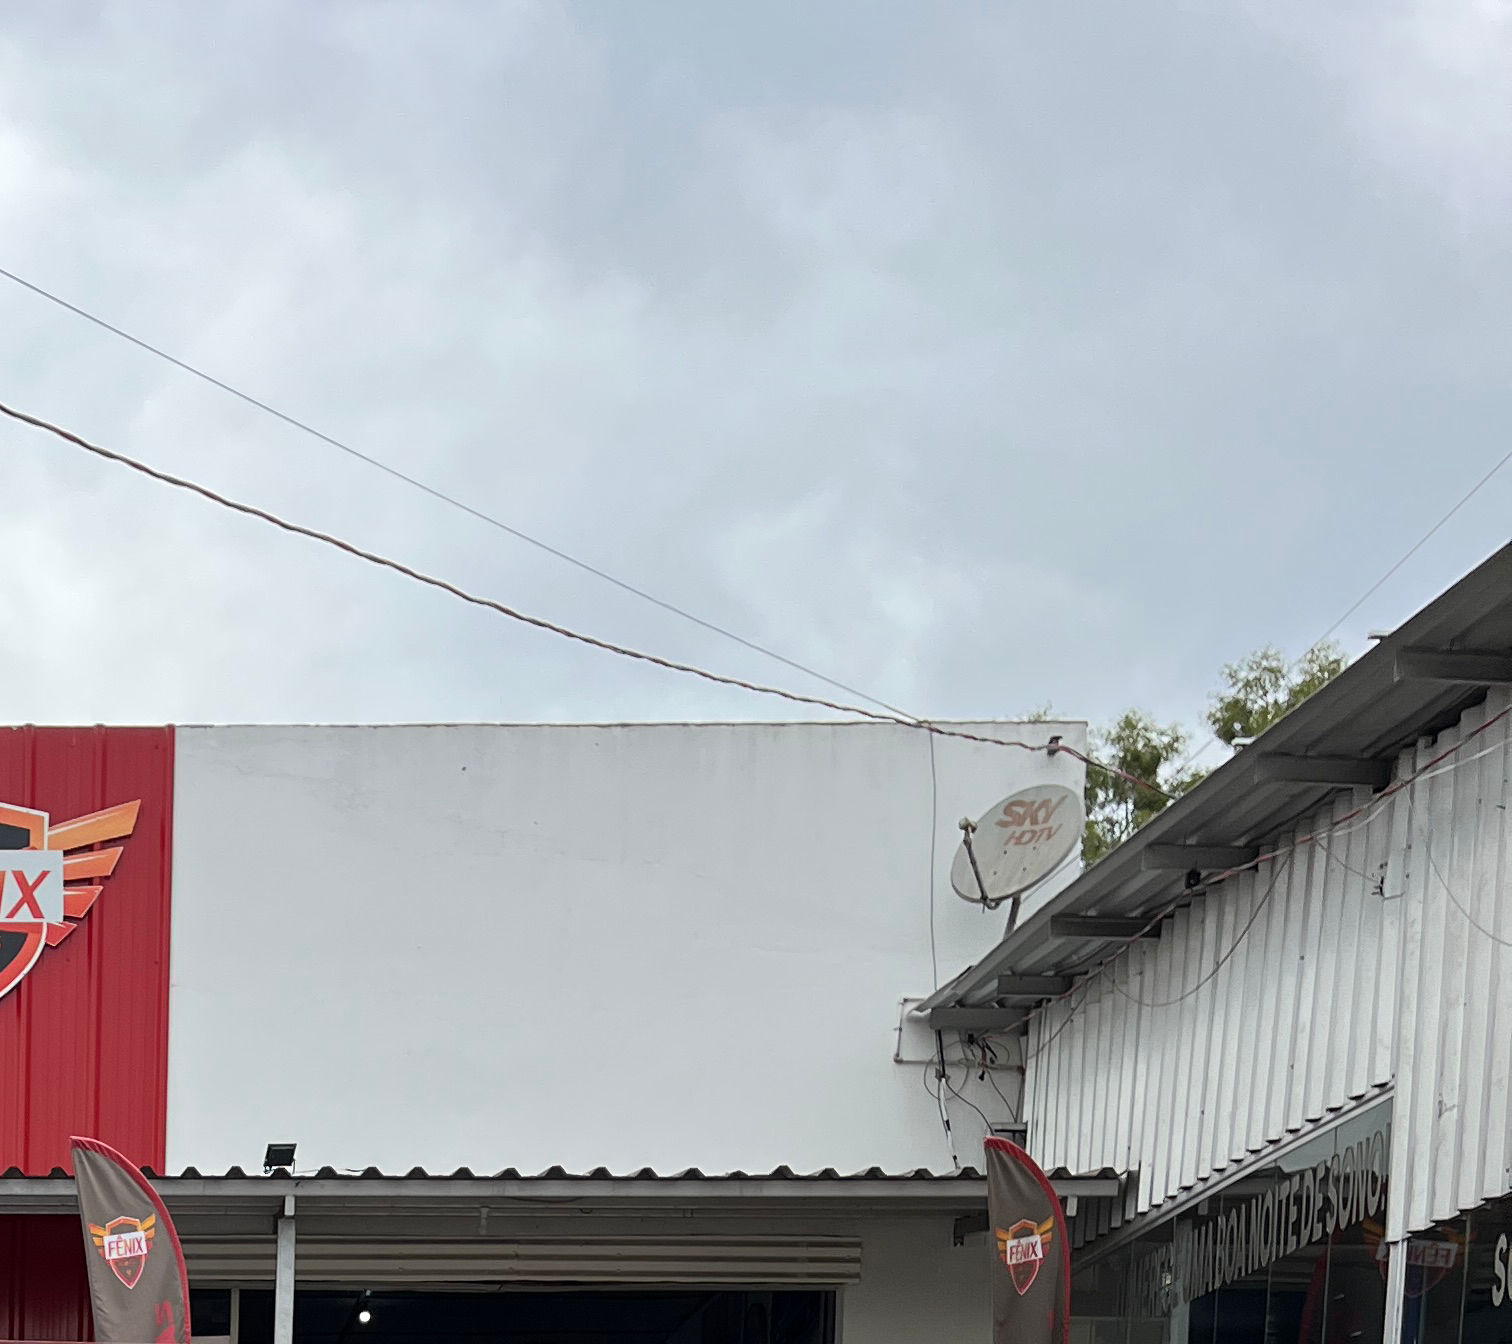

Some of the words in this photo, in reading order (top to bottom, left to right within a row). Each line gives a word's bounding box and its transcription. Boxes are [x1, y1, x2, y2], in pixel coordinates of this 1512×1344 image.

[995, 795, 1068, 828] SKY
[1004, 824, 1063, 846] HDTV
[1214, 1203, 1246, 1289] BOA
[1248, 1173, 1300, 1275] NOITE
[1299, 1160, 1326, 1249] DE
[108, 1234, 144, 1257] FÊNIX
